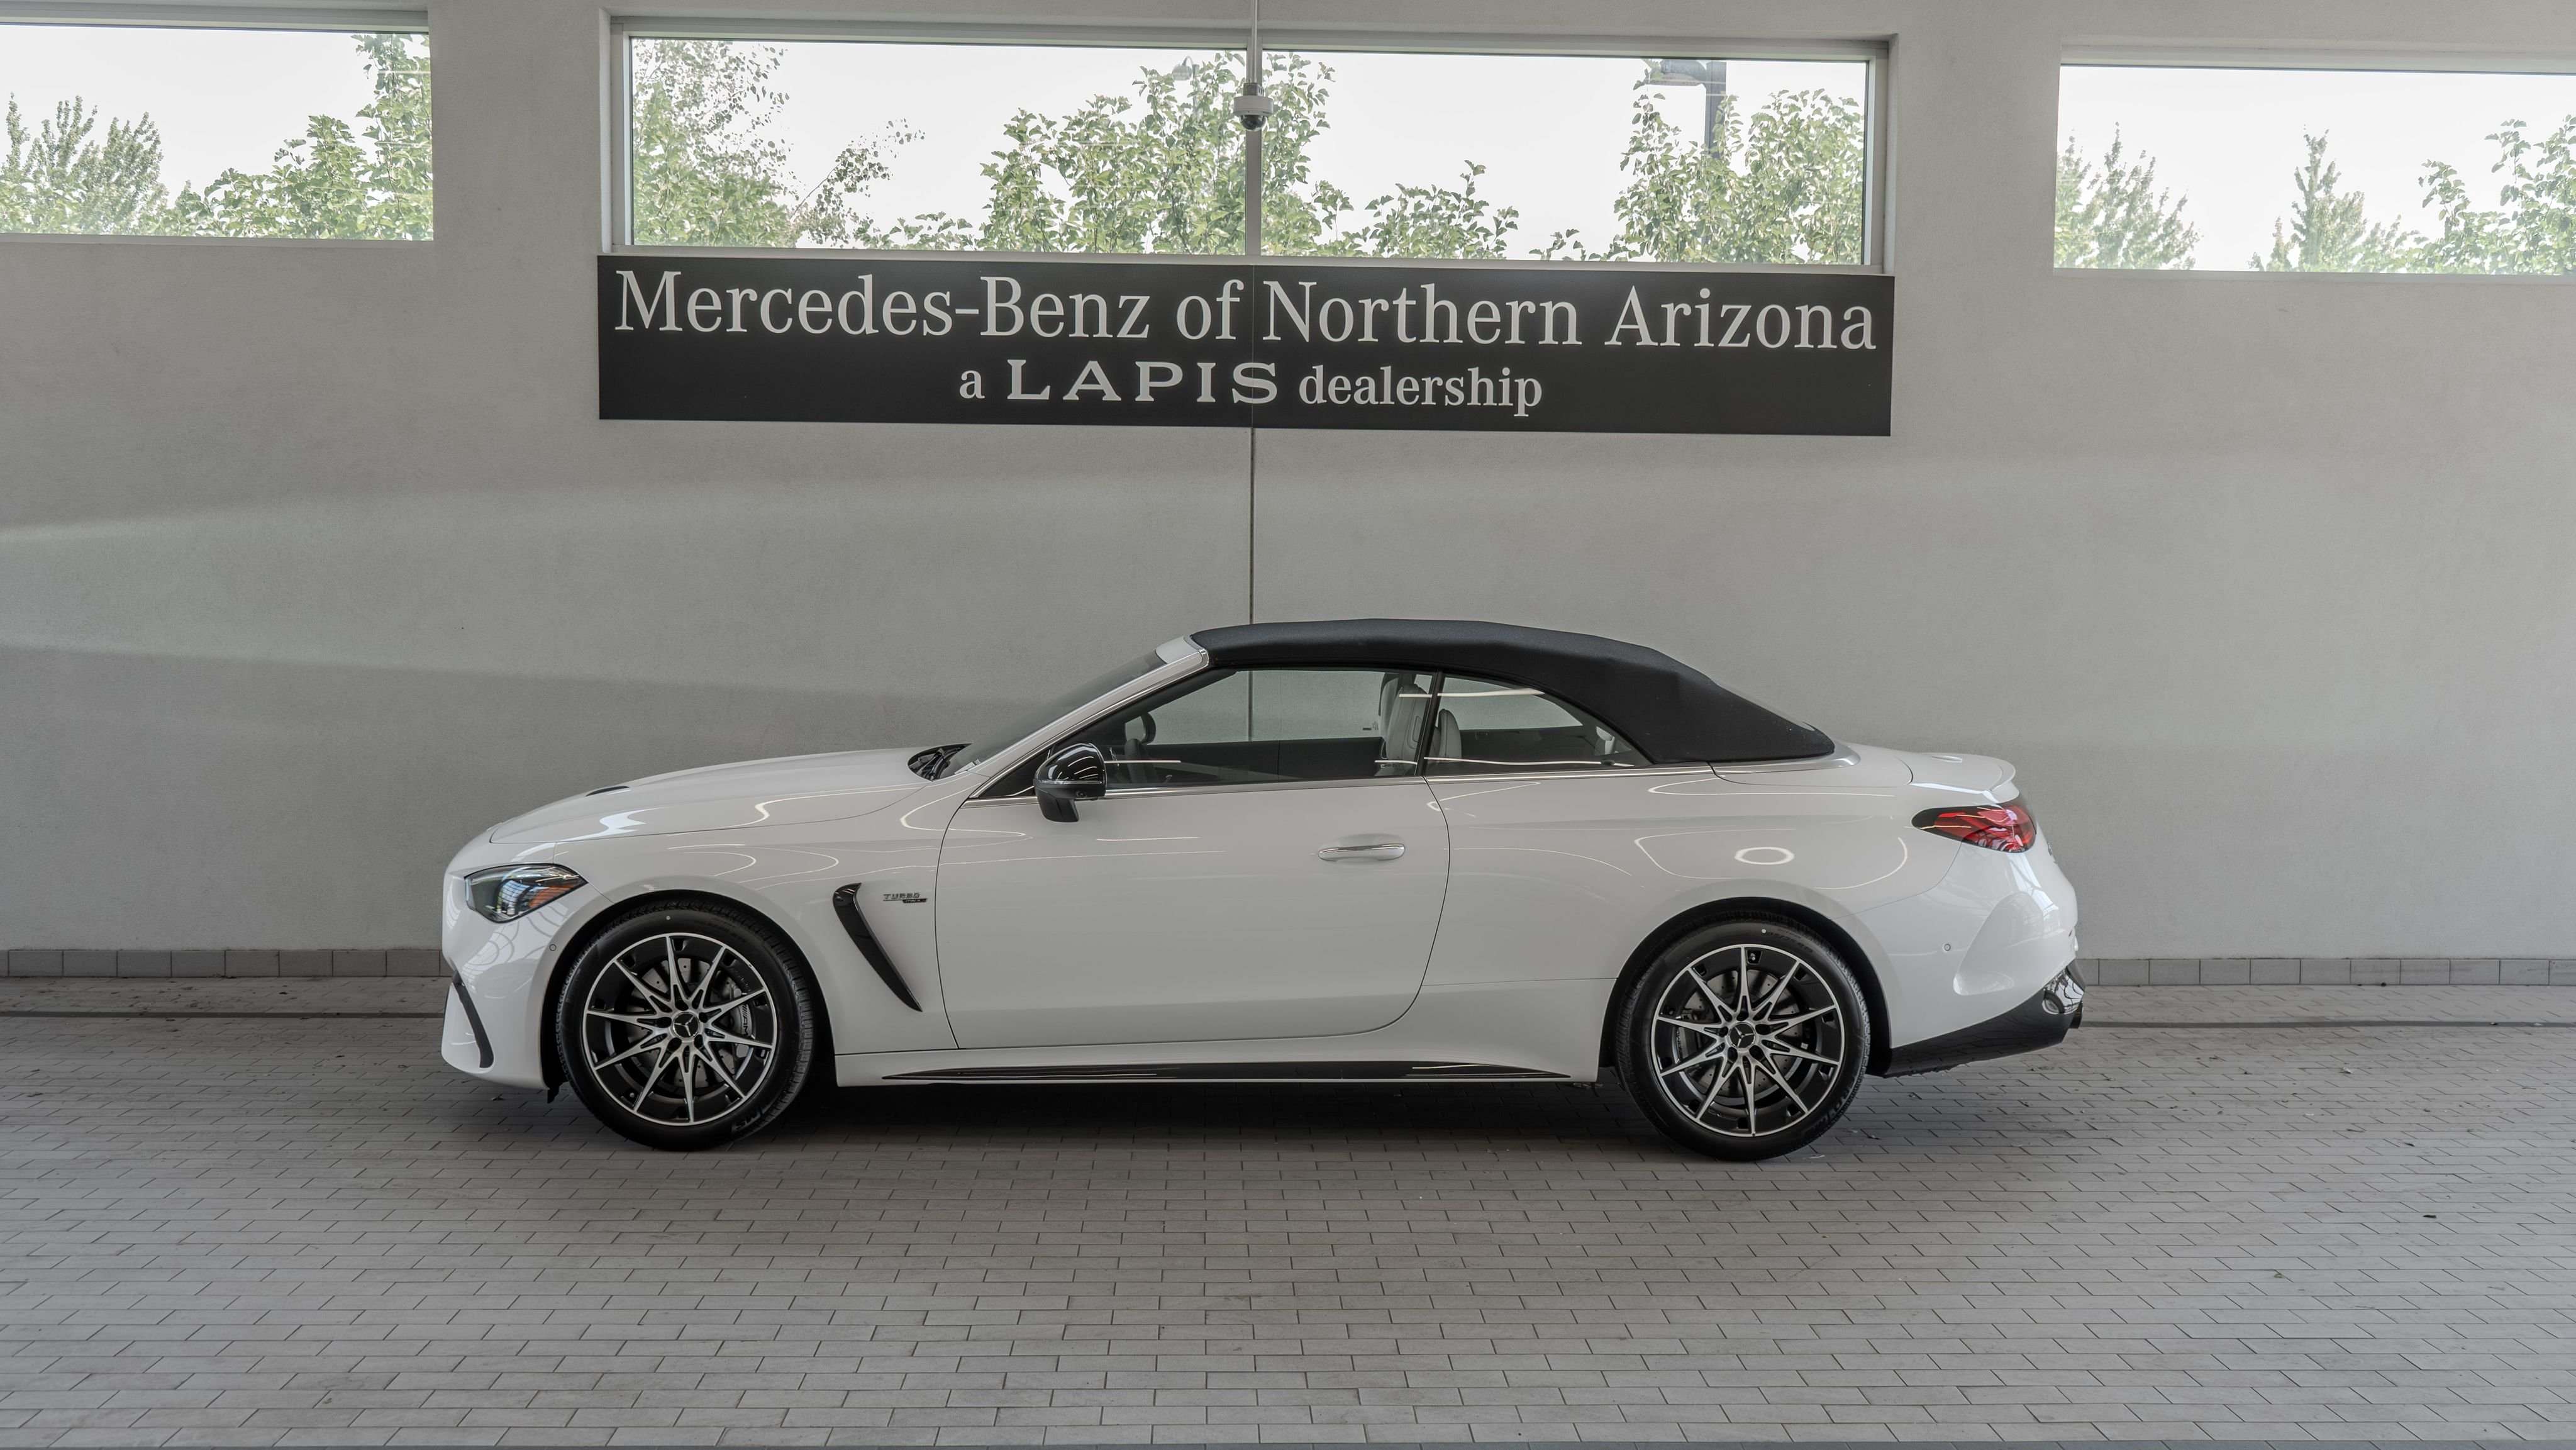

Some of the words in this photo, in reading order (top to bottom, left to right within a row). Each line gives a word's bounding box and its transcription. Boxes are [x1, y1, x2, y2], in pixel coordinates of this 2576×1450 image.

[614, 270, 1151, 338] Mercedes-Benz
[1176, 279, 1245, 340] of
[1262, 281, 1582, 345] Northern
[1604, 284, 1877, 350] Arizona
[959, 370, 985, 399] a
[1007, 359, 1277, 404] LAPIS
[1299, 364, 1543, 417] dealership
